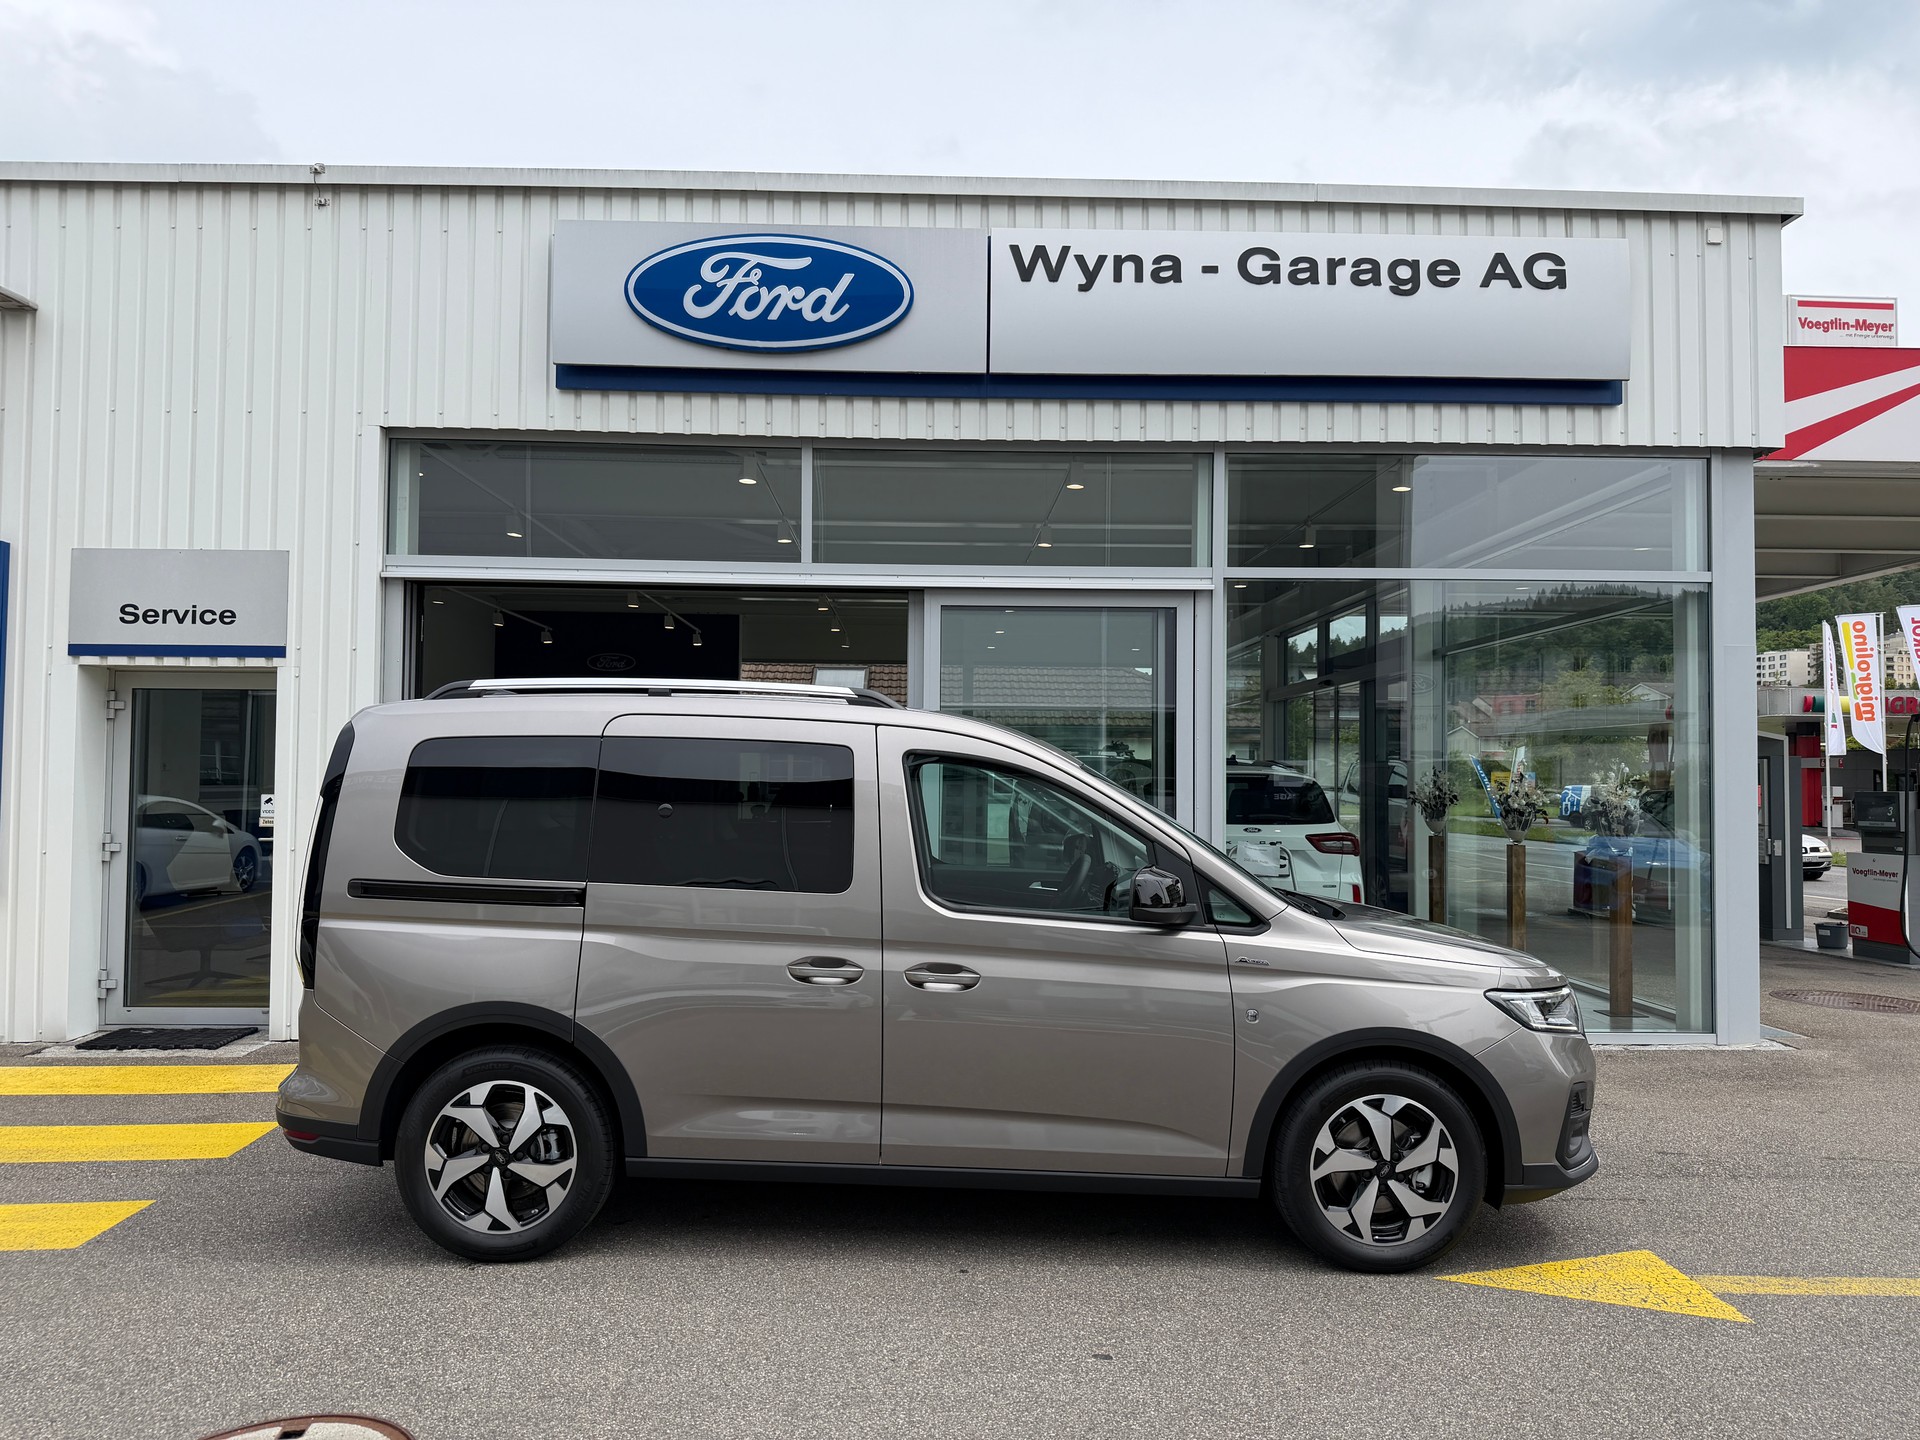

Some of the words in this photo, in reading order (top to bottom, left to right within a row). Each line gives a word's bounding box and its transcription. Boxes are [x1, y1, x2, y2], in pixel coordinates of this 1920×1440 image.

[1010, 244, 1182, 292] Wyna
[1202, 265, 1219, 274] -
[1238, 246, 1461, 297] Garage
[1480, 252, 1567, 290] AG
[683, 251, 855, 323] Ford
[1798, 317, 1894, 335] Voegtlin-Meyer
[119, 603, 237, 626] Service
[596, 655, 627, 669] Ford
[1887, 806, 1894, 816] 3
[1852, 867, 1899, 879] Voegtlin-Meyer
